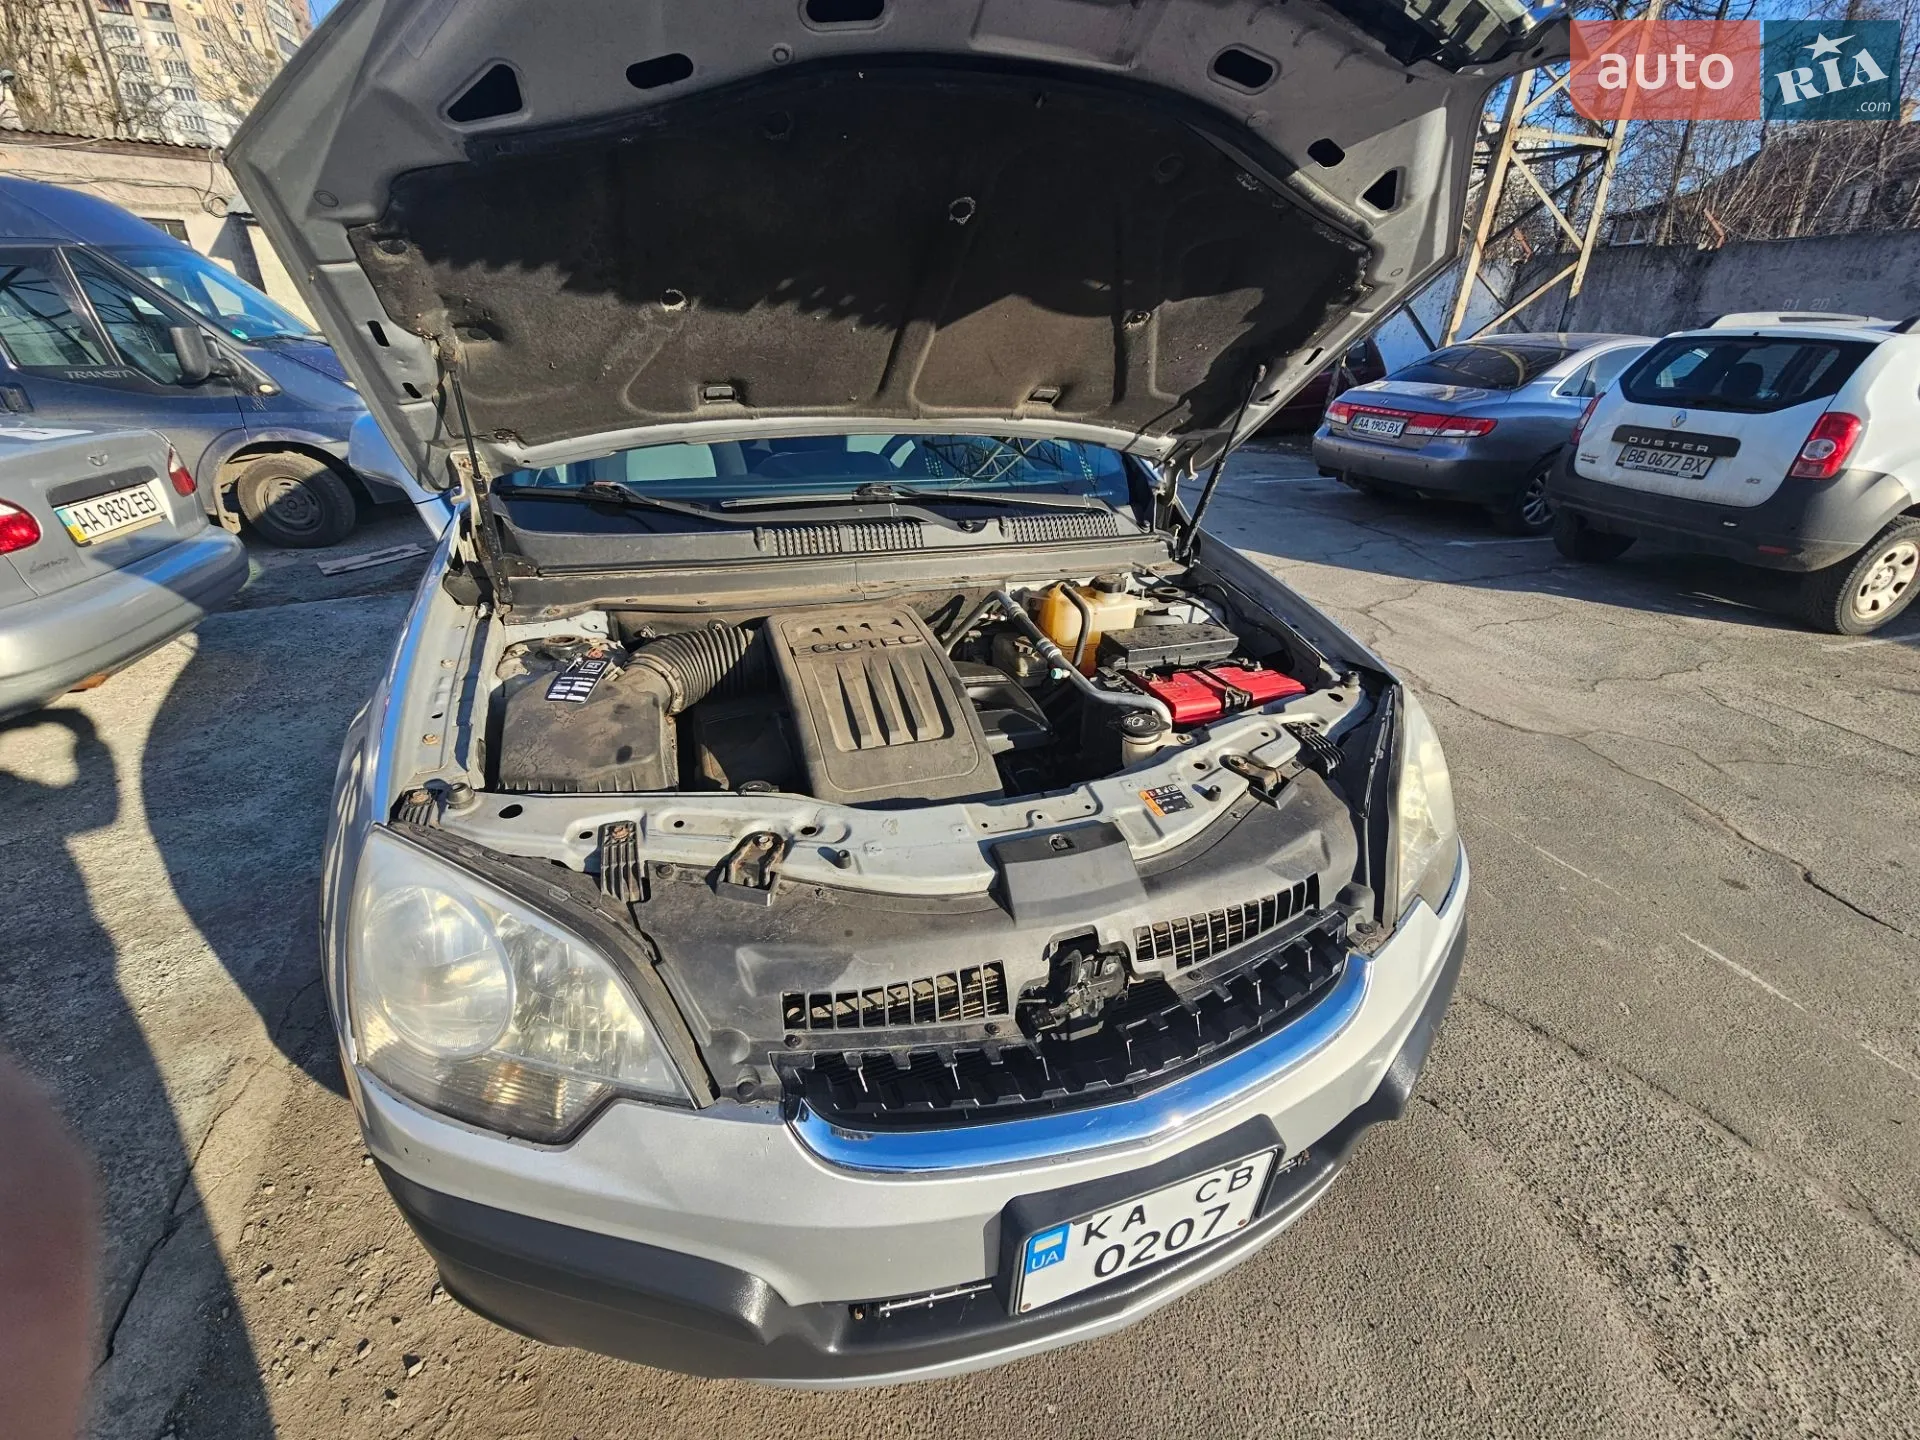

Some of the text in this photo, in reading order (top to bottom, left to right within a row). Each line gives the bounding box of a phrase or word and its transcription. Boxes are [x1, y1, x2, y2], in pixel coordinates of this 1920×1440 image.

[64, 369, 128, 379] TRANSIT
[1359, 417, 1401, 433] AA 1905 BX
[1628, 435, 1709, 452] DUSTER
[1627, 449, 1647, 463] BB
[1648, 452, 1682, 469] 0677
[1681, 456, 1707, 473] BX
[73, 491, 157, 535] AA 9832 EB
[1083, 1165, 1255, 1246] KA CB
[1094, 1202, 1231, 1278] 0207
[1031, 1252, 1060, 1270] UA
